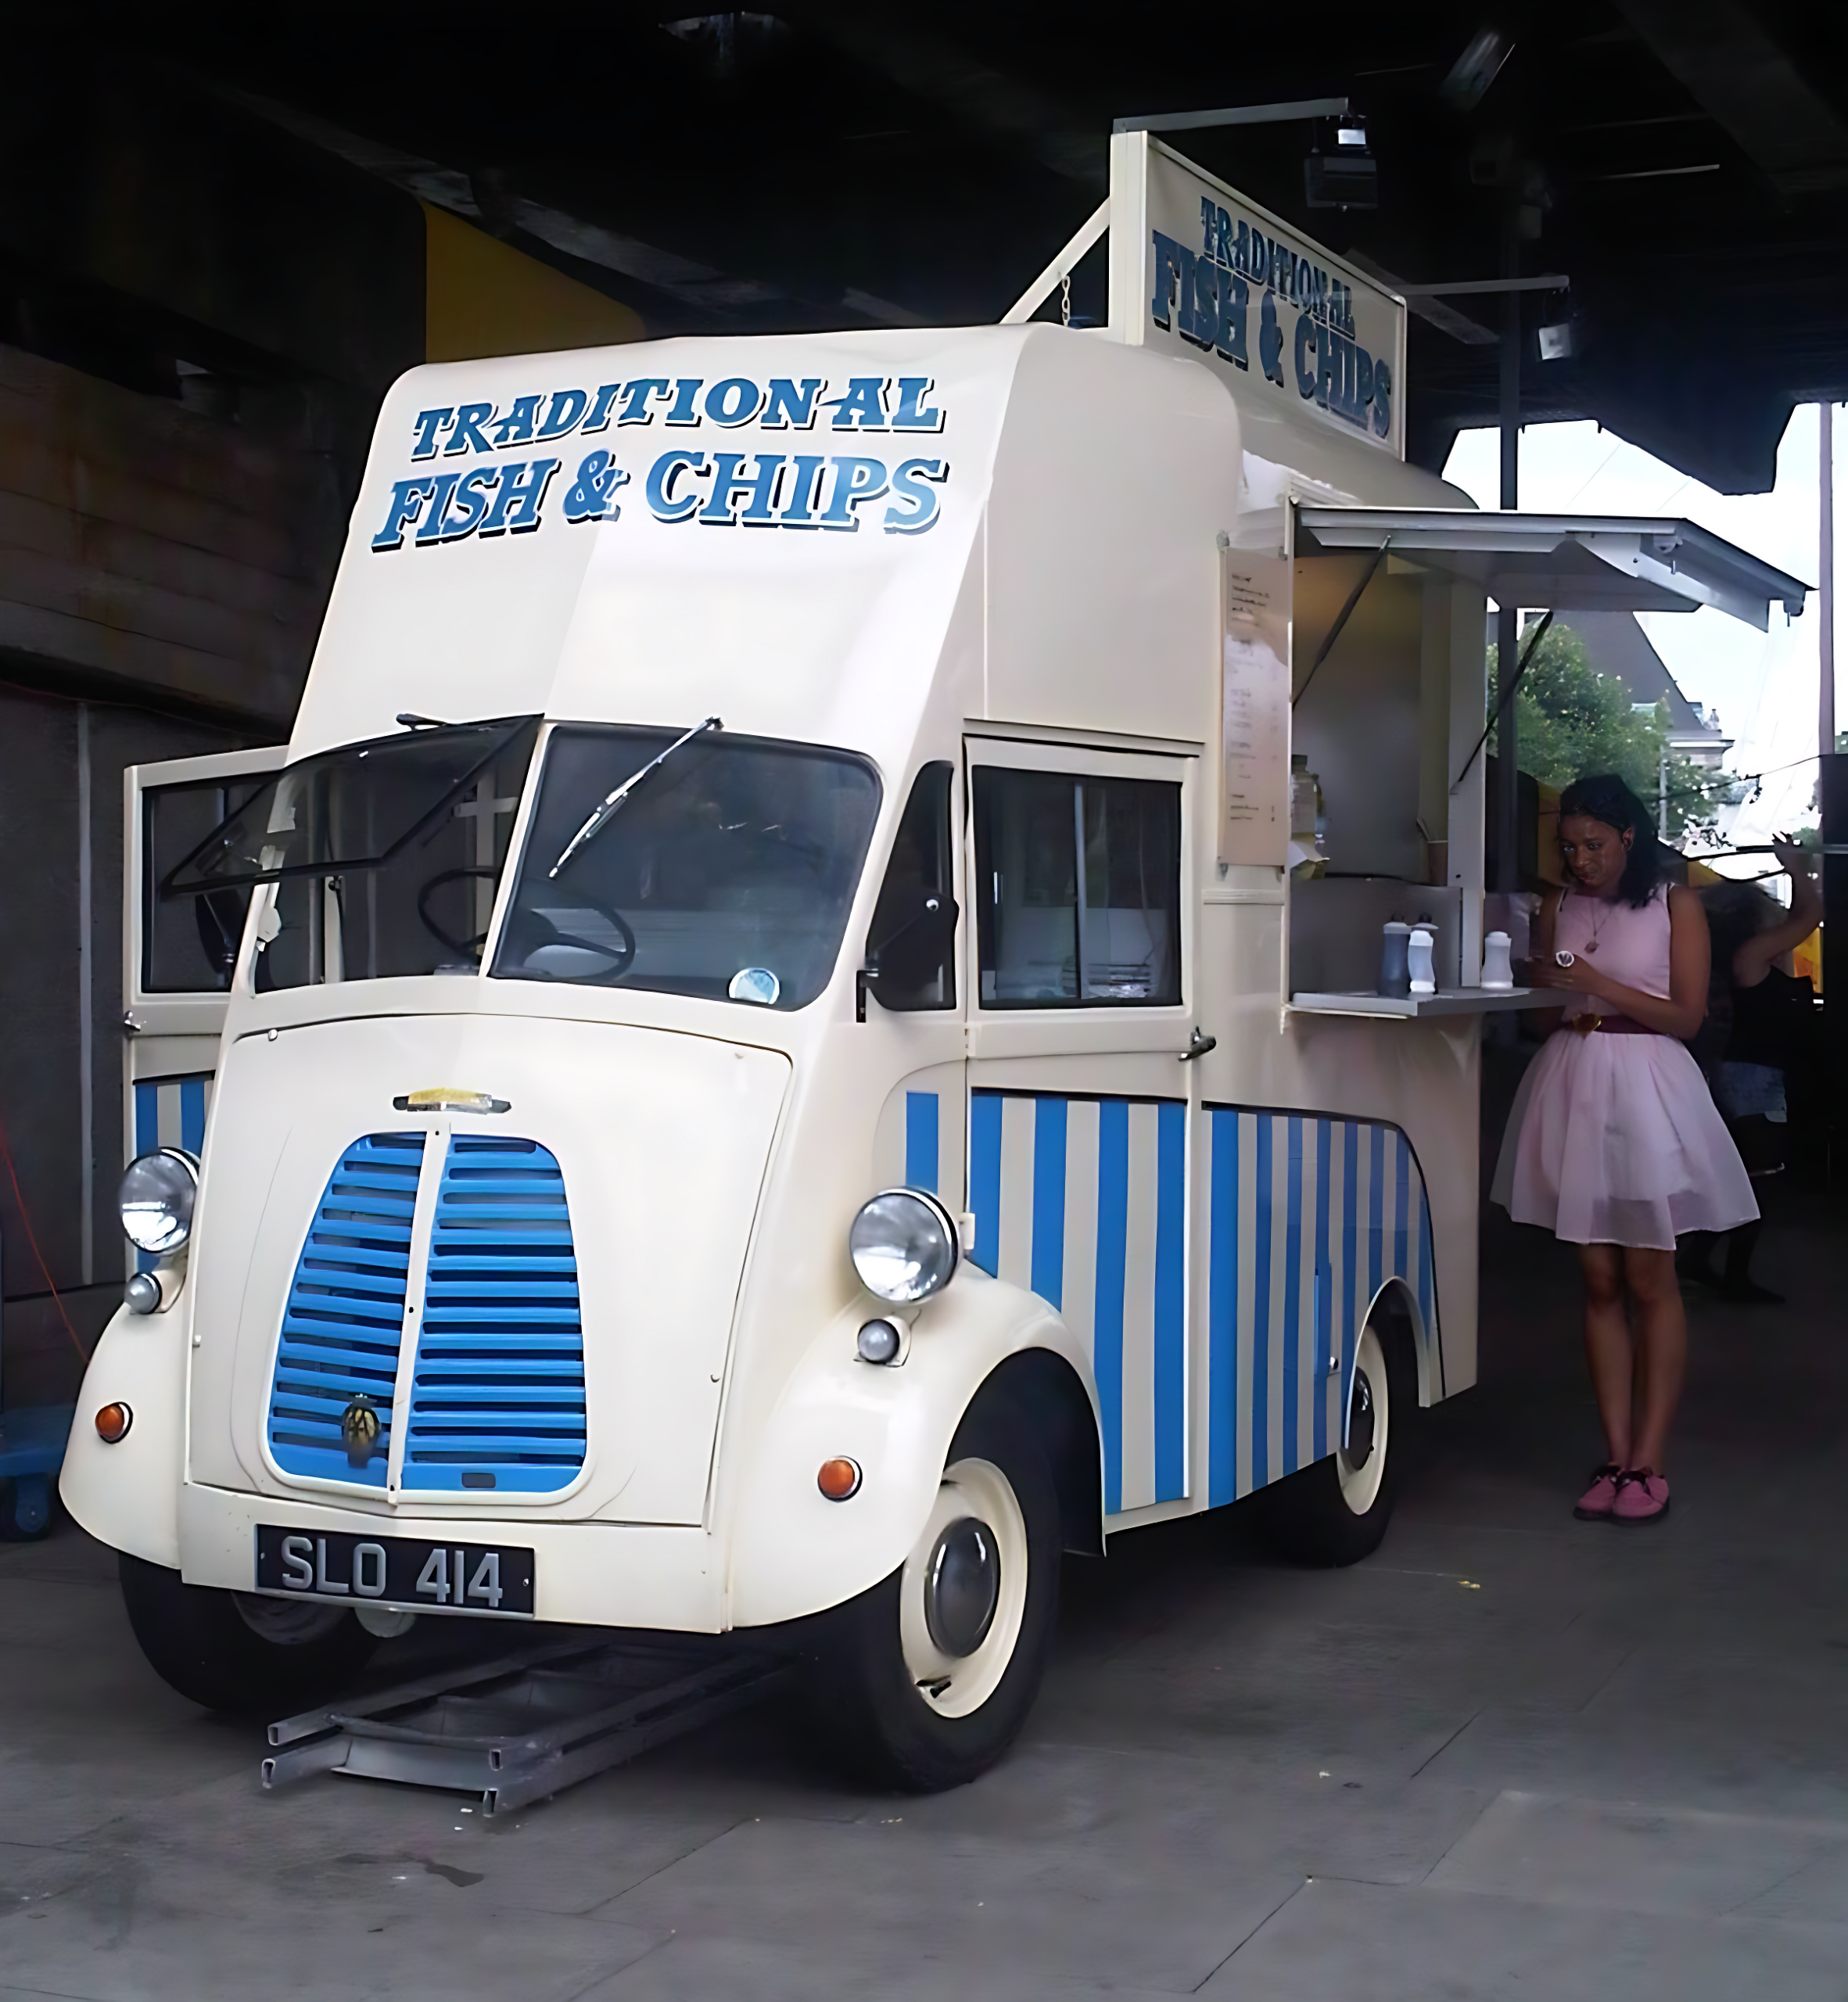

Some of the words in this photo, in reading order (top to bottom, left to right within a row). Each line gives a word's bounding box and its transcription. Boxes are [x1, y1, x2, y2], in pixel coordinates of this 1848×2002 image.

[1200, 196, 1356, 341] TRADITIONAL
[1152, 229, 1249, 371] FISH
[1259, 289, 1284, 389] &
[1294, 313, 1392, 440] CHIPS
[411, 377, 947, 461] TRADITIONAL
[371, 457, 562, 553] FISH
[563, 448, 630, 525] &
[646, 450, 950, 536] CHIPS
[281, 1535, 386, 1597] SLO
[415, 1548, 503, 1607] 414
